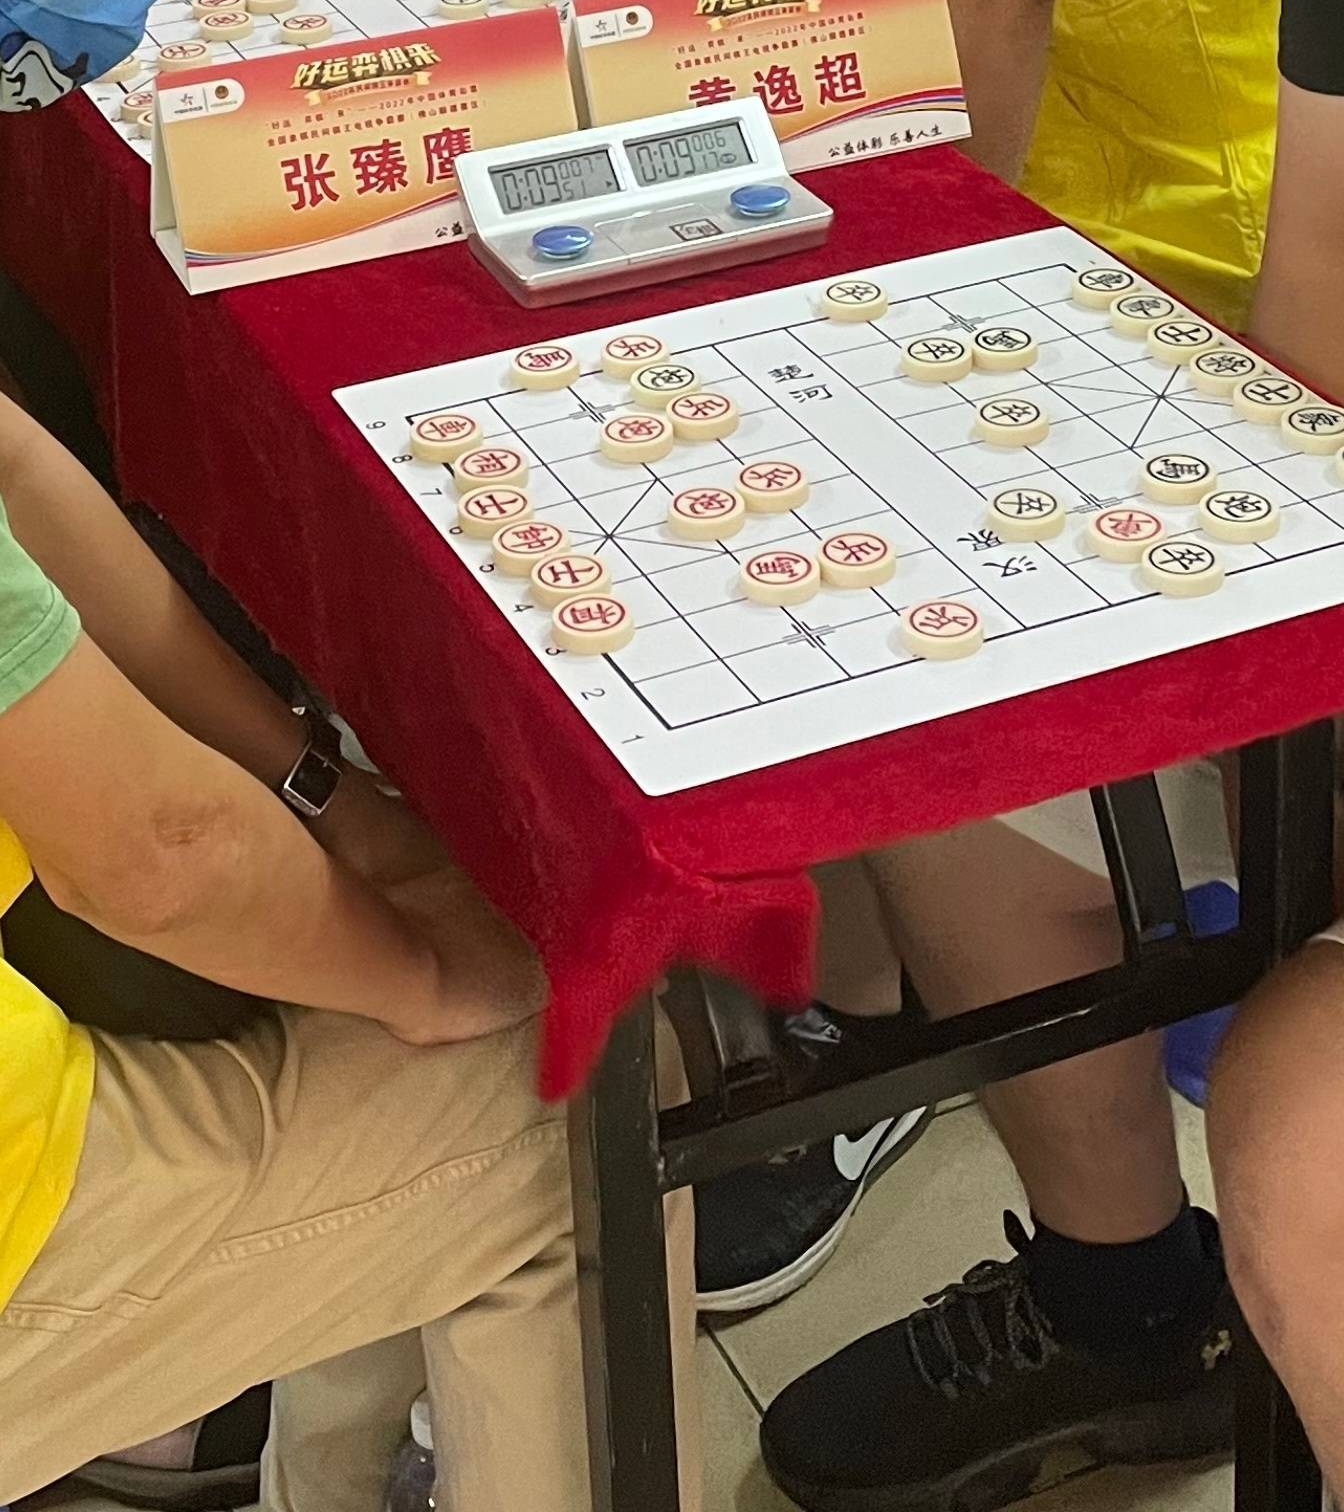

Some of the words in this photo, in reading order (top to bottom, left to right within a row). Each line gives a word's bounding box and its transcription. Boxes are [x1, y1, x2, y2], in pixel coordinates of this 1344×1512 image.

[688, 51, 867, 117] 黄逸超
[888, 125, 943, 147] 乐善人生
[636, 139, 696, 184] 0:09
[501, 165, 564, 211] 0:09
[766, 365, 835, 405] 楚河
[578, 686, 607, 702] 2
